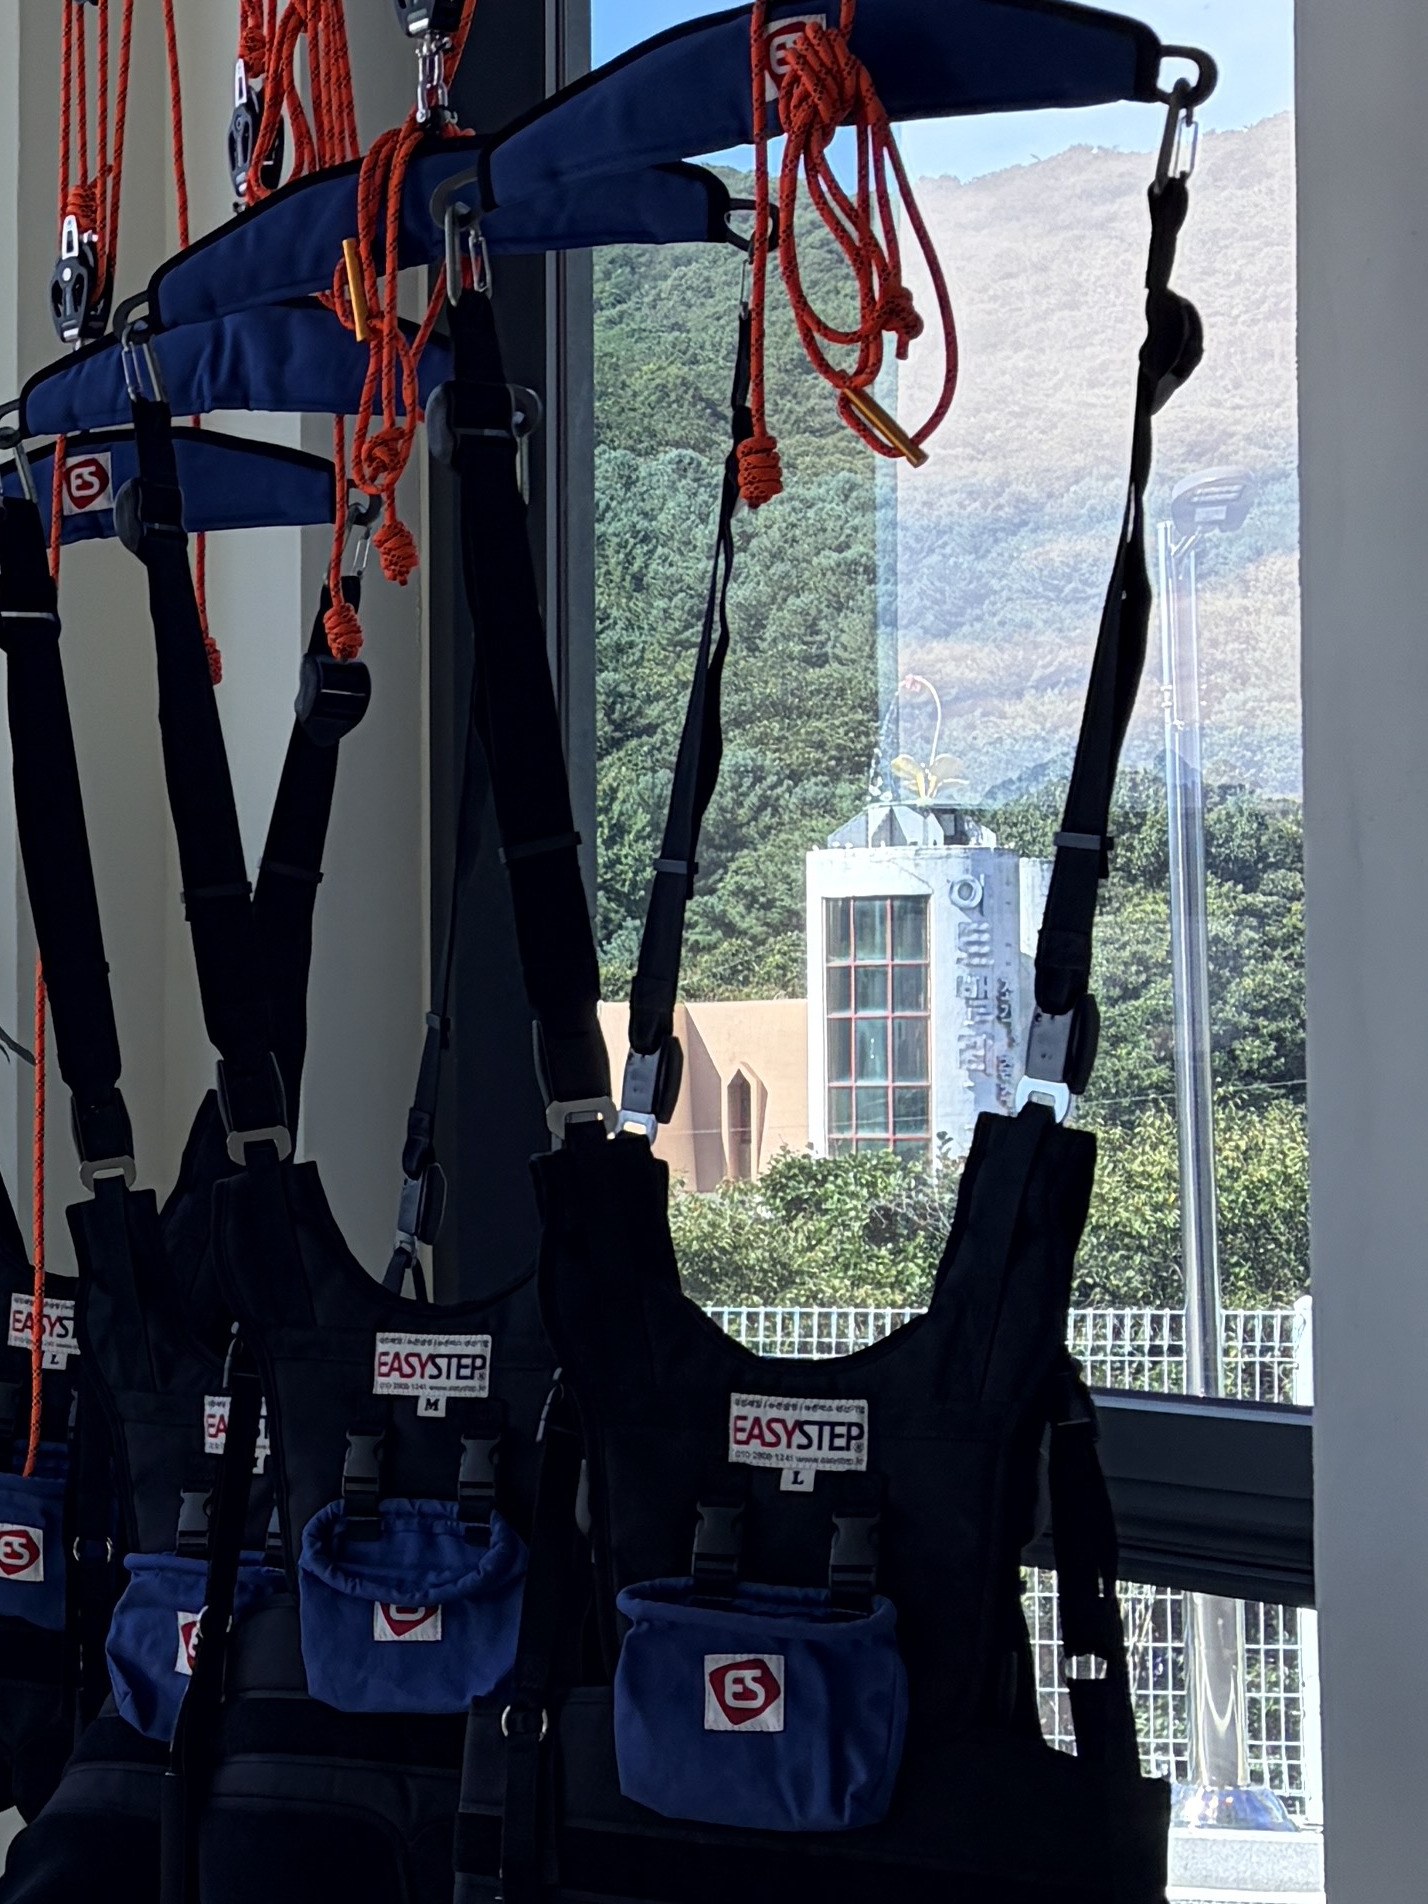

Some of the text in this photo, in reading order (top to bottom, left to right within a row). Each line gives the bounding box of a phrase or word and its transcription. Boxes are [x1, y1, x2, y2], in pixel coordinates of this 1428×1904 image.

[70, 466, 100, 497] ES
[50, 1354, 60, 1365] L
[378, 1351, 487, 1380] EASYSTEP
[425, 1398, 440, 1411] M
[733, 1415, 865, 1452] EASYSTEP
[791, 1470, 804, 1485] L
[724, 1669, 766, 1709] ES
